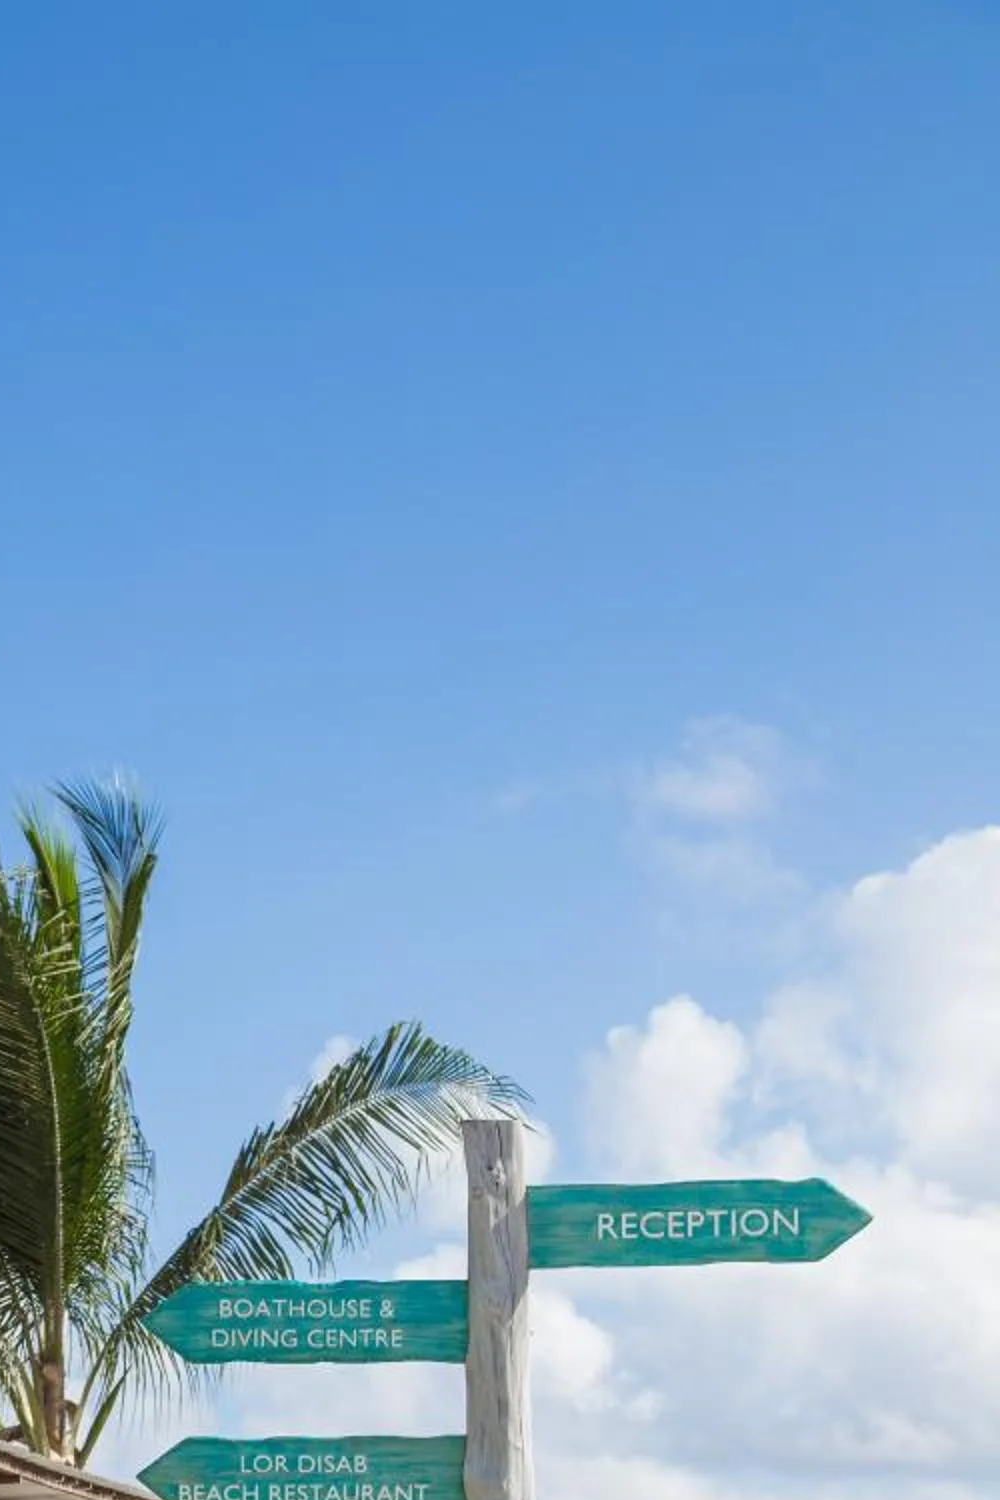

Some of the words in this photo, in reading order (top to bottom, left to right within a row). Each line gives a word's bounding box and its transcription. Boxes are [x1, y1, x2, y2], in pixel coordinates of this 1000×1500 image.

[597, 1208, 800, 1240] RECEPTION
[218, 1299, 372, 1319] BOATHOUSE
[379, 1299, 395, 1319] &
[211, 1329, 298, 1349] DIVING
[307, 1329, 404, 1349] CENTRE
[240, 1455, 289, 1474] LOR
[297, 1455, 368, 1474] DISAB
